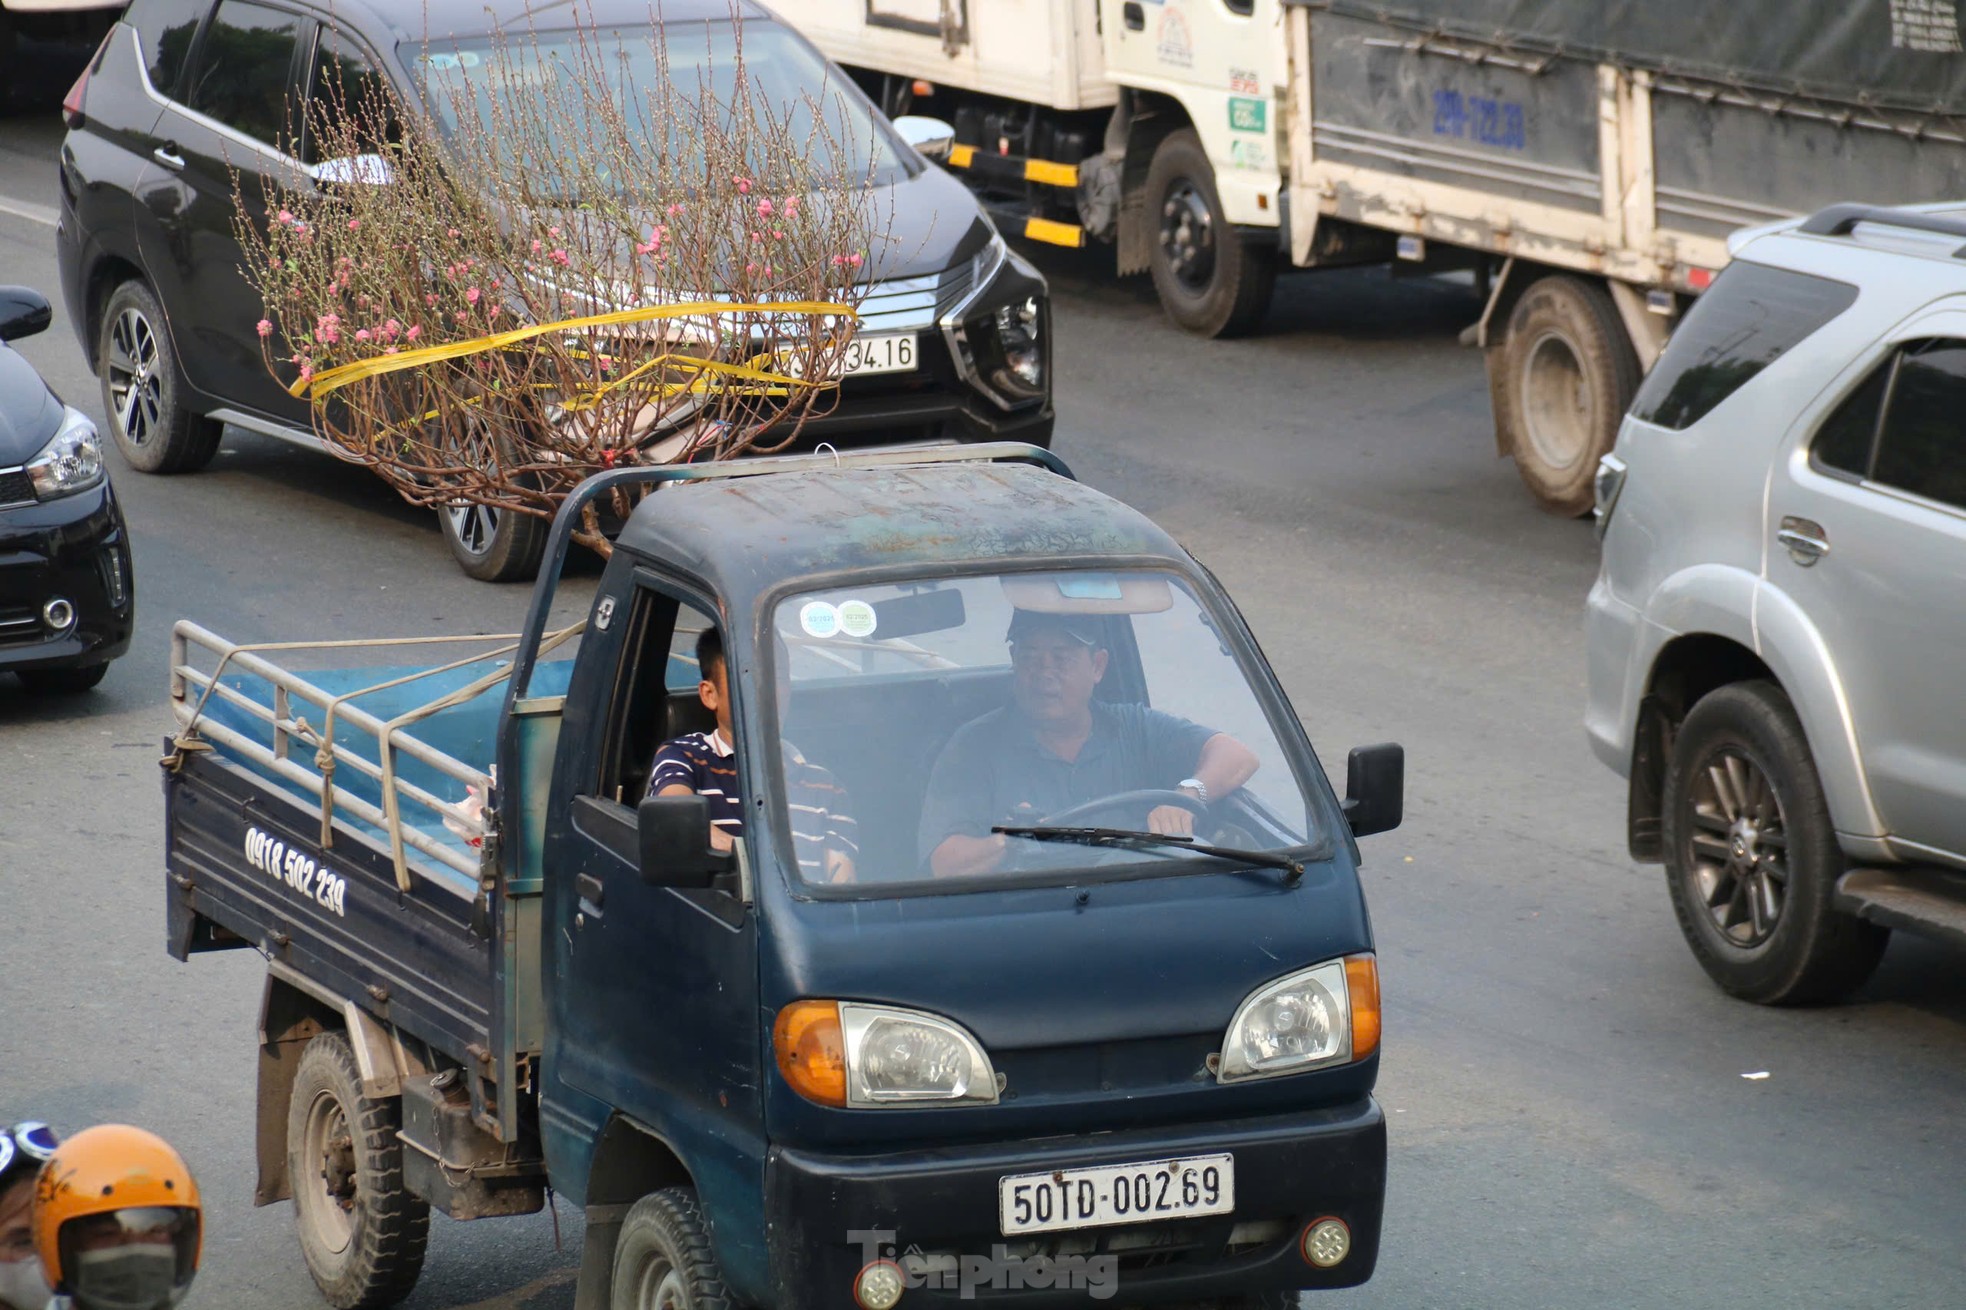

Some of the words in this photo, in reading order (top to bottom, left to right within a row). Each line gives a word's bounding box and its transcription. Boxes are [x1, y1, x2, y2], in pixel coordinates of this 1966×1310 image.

[848, 337, 912, 370] 34.16
[245, 827, 284, 880] 0918
[284, 849, 315, 899] 502
[316, 868, 346, 917] 239
[1014, 1165, 1221, 1226] 50TD-002.69
